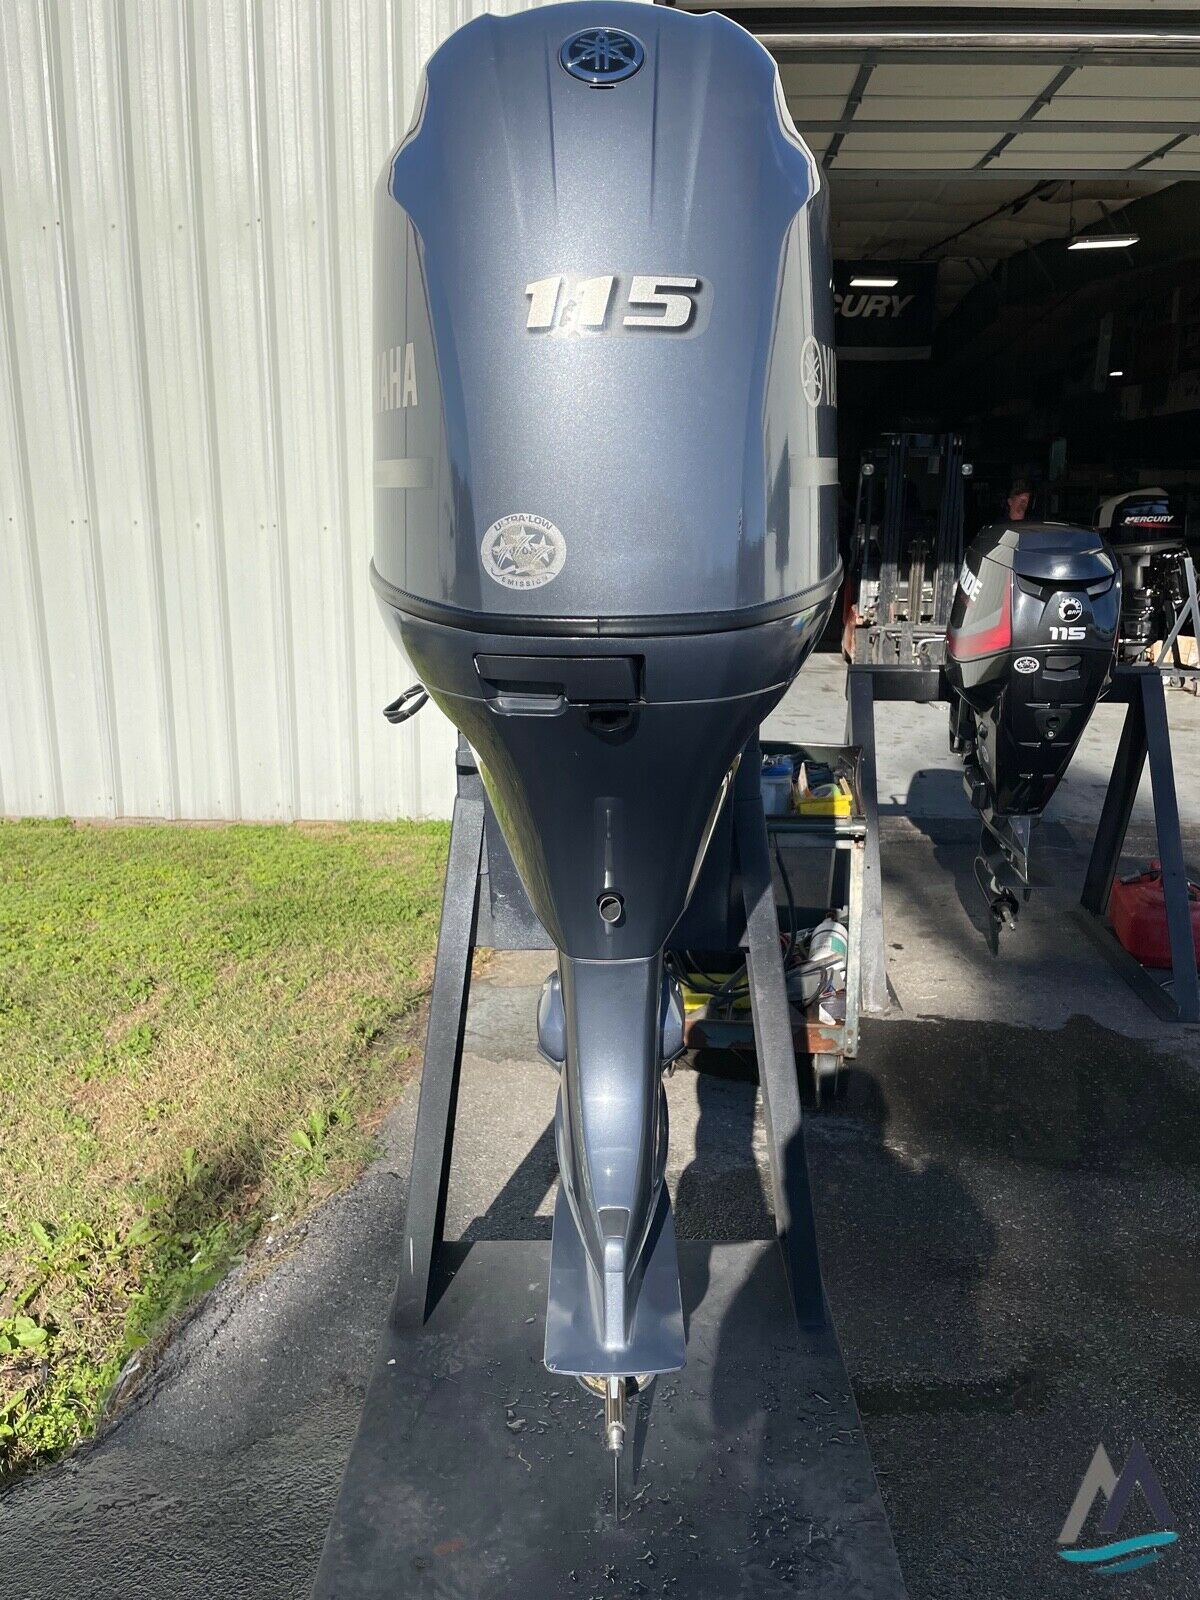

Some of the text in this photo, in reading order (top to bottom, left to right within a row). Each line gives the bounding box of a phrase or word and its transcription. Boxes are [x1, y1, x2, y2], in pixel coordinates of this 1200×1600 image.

[525, 275, 699, 330] 115
[376, 343, 418, 413] AHA
[1124, 515, 1174, 525] MERCURY
[1049, 626, 1087, 640] 115
